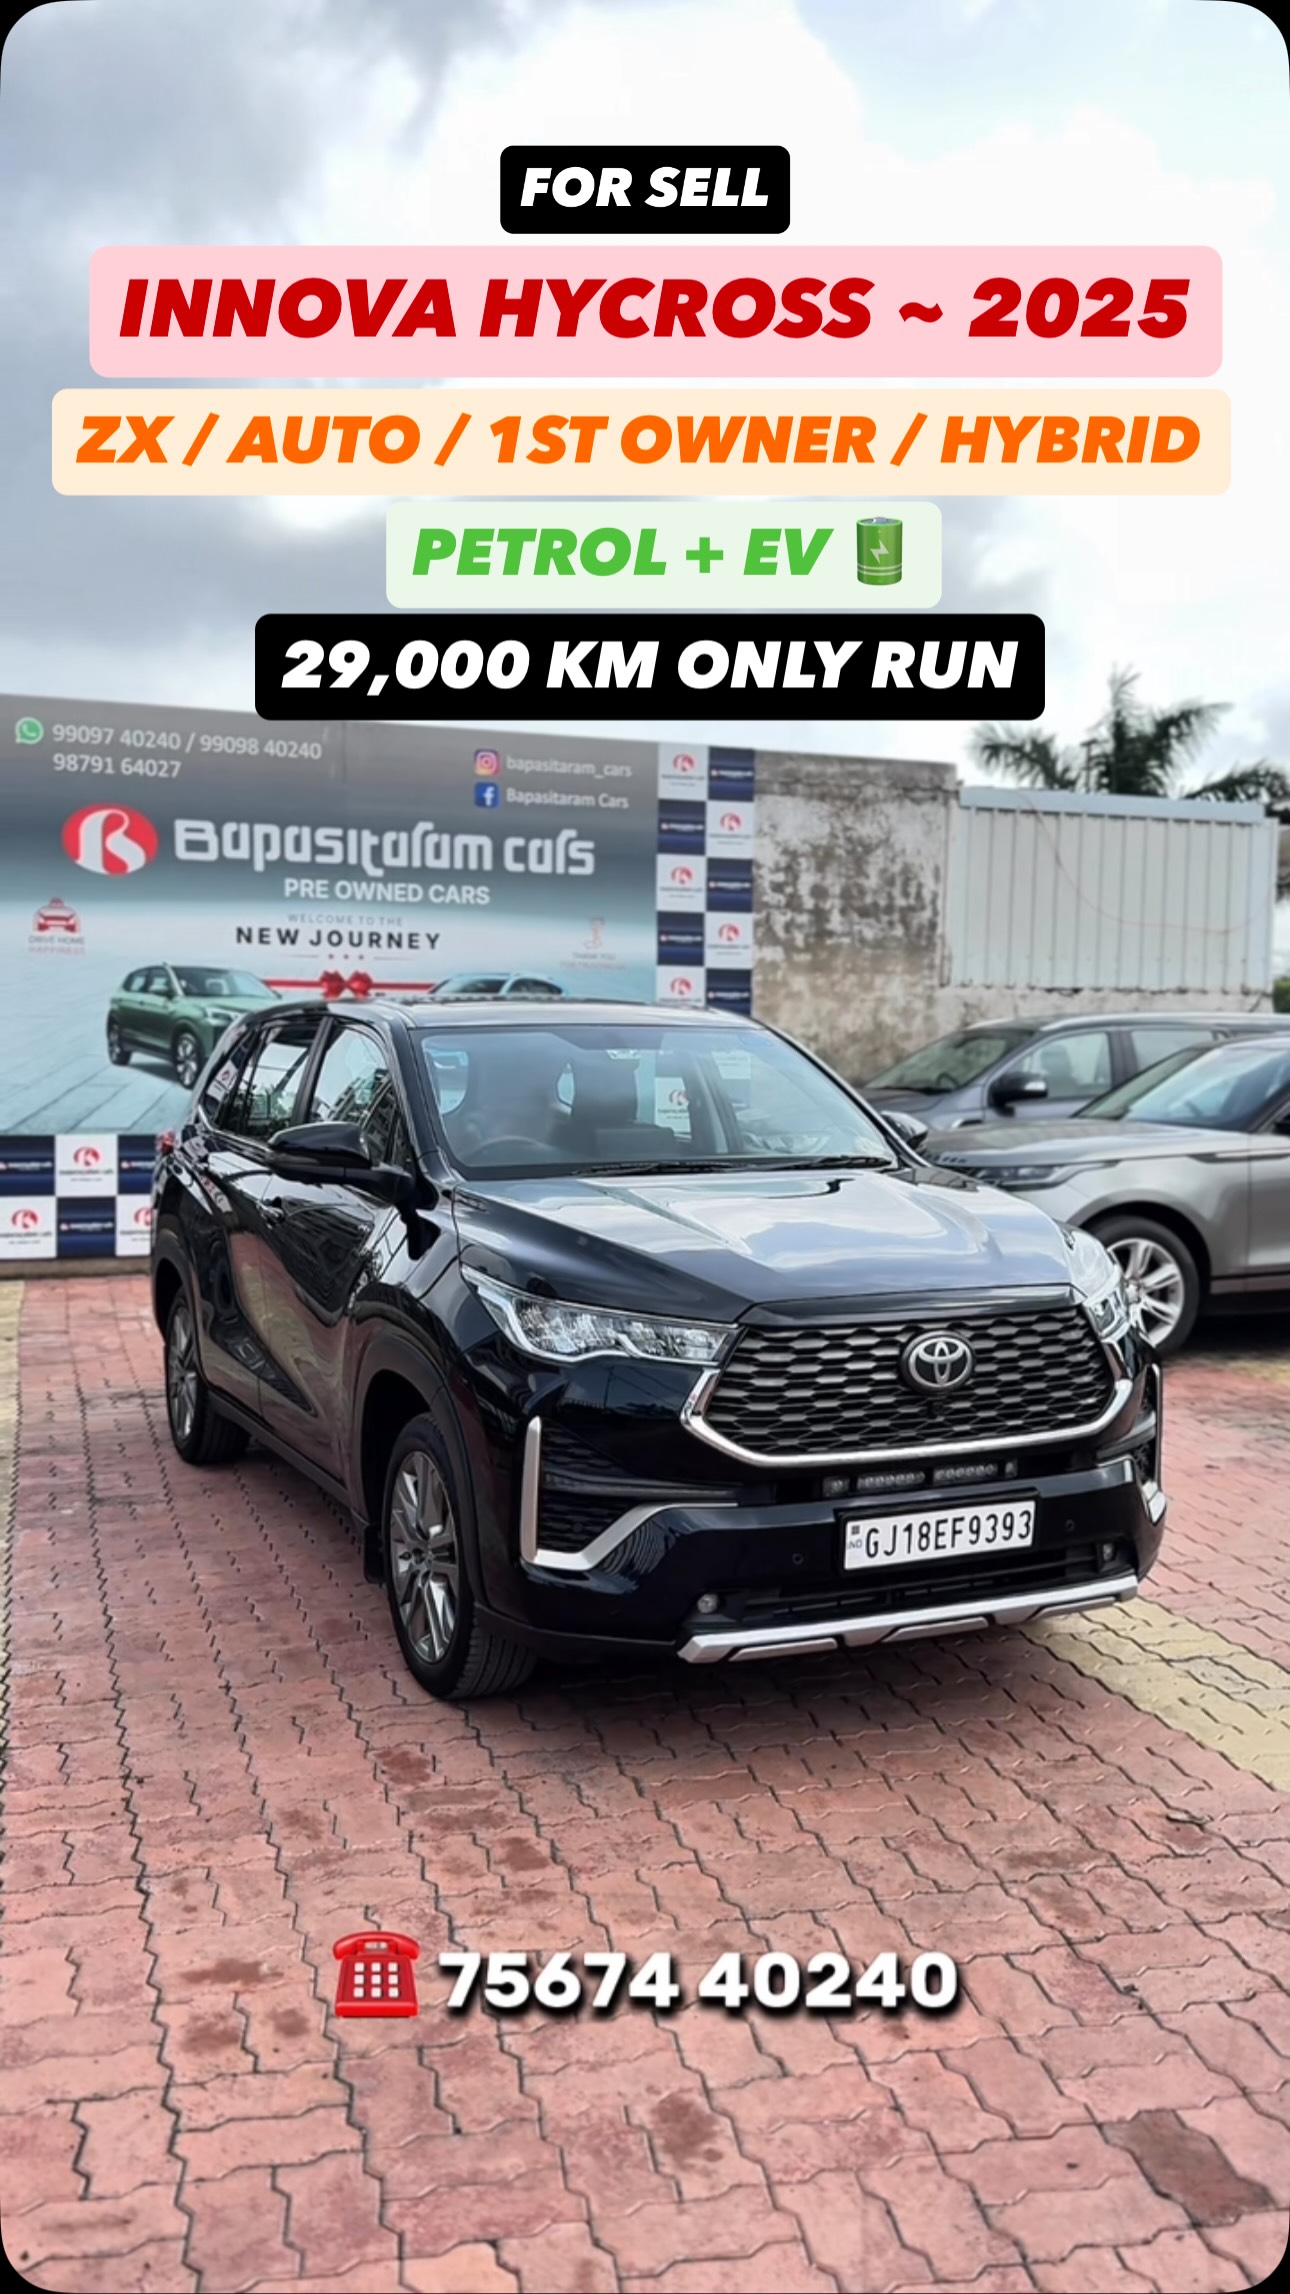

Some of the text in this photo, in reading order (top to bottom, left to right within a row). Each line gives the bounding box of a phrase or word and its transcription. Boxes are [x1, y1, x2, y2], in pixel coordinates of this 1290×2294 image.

[52, 723, 322, 760] 99097 40240 / 99098 40240
[53, 753, 181, 778] 98791 64027
[506, 756, 632, 779] bapasitaram_cars
[506, 787, 629, 809] Bapasitaram Cars
[504, 829, 595, 876] cars
[284, 878, 490, 905] PRE OWNED CARS
[287, 913, 403, 927] WELCOME TO THE
[236, 926, 441, 950] NEW JOURNEY
[865, 1509, 1032, 1559] GJ18EF9393
